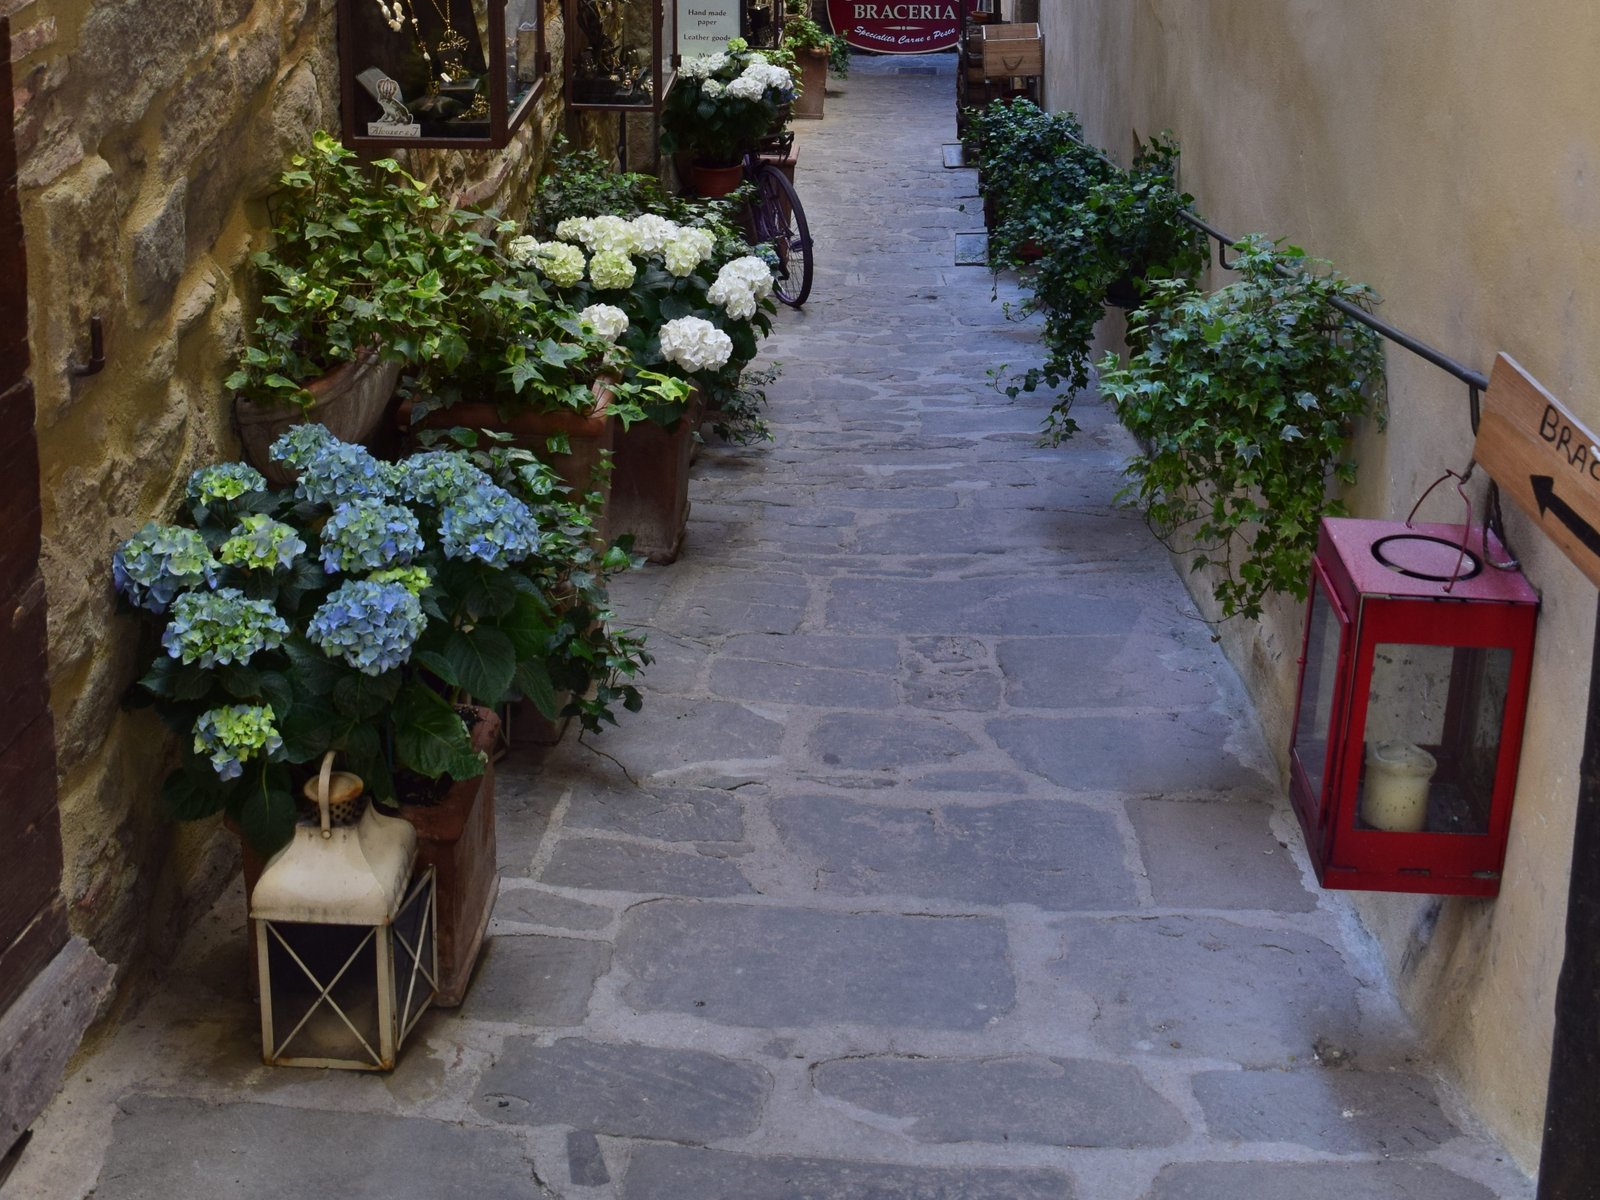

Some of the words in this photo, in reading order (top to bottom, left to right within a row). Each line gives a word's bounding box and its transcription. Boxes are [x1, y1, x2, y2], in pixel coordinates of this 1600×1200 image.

[853, 4, 957, 20] BRACERIA
[854, 25, 896, 43] Specialità
[898, 35, 924, 45] Carne
